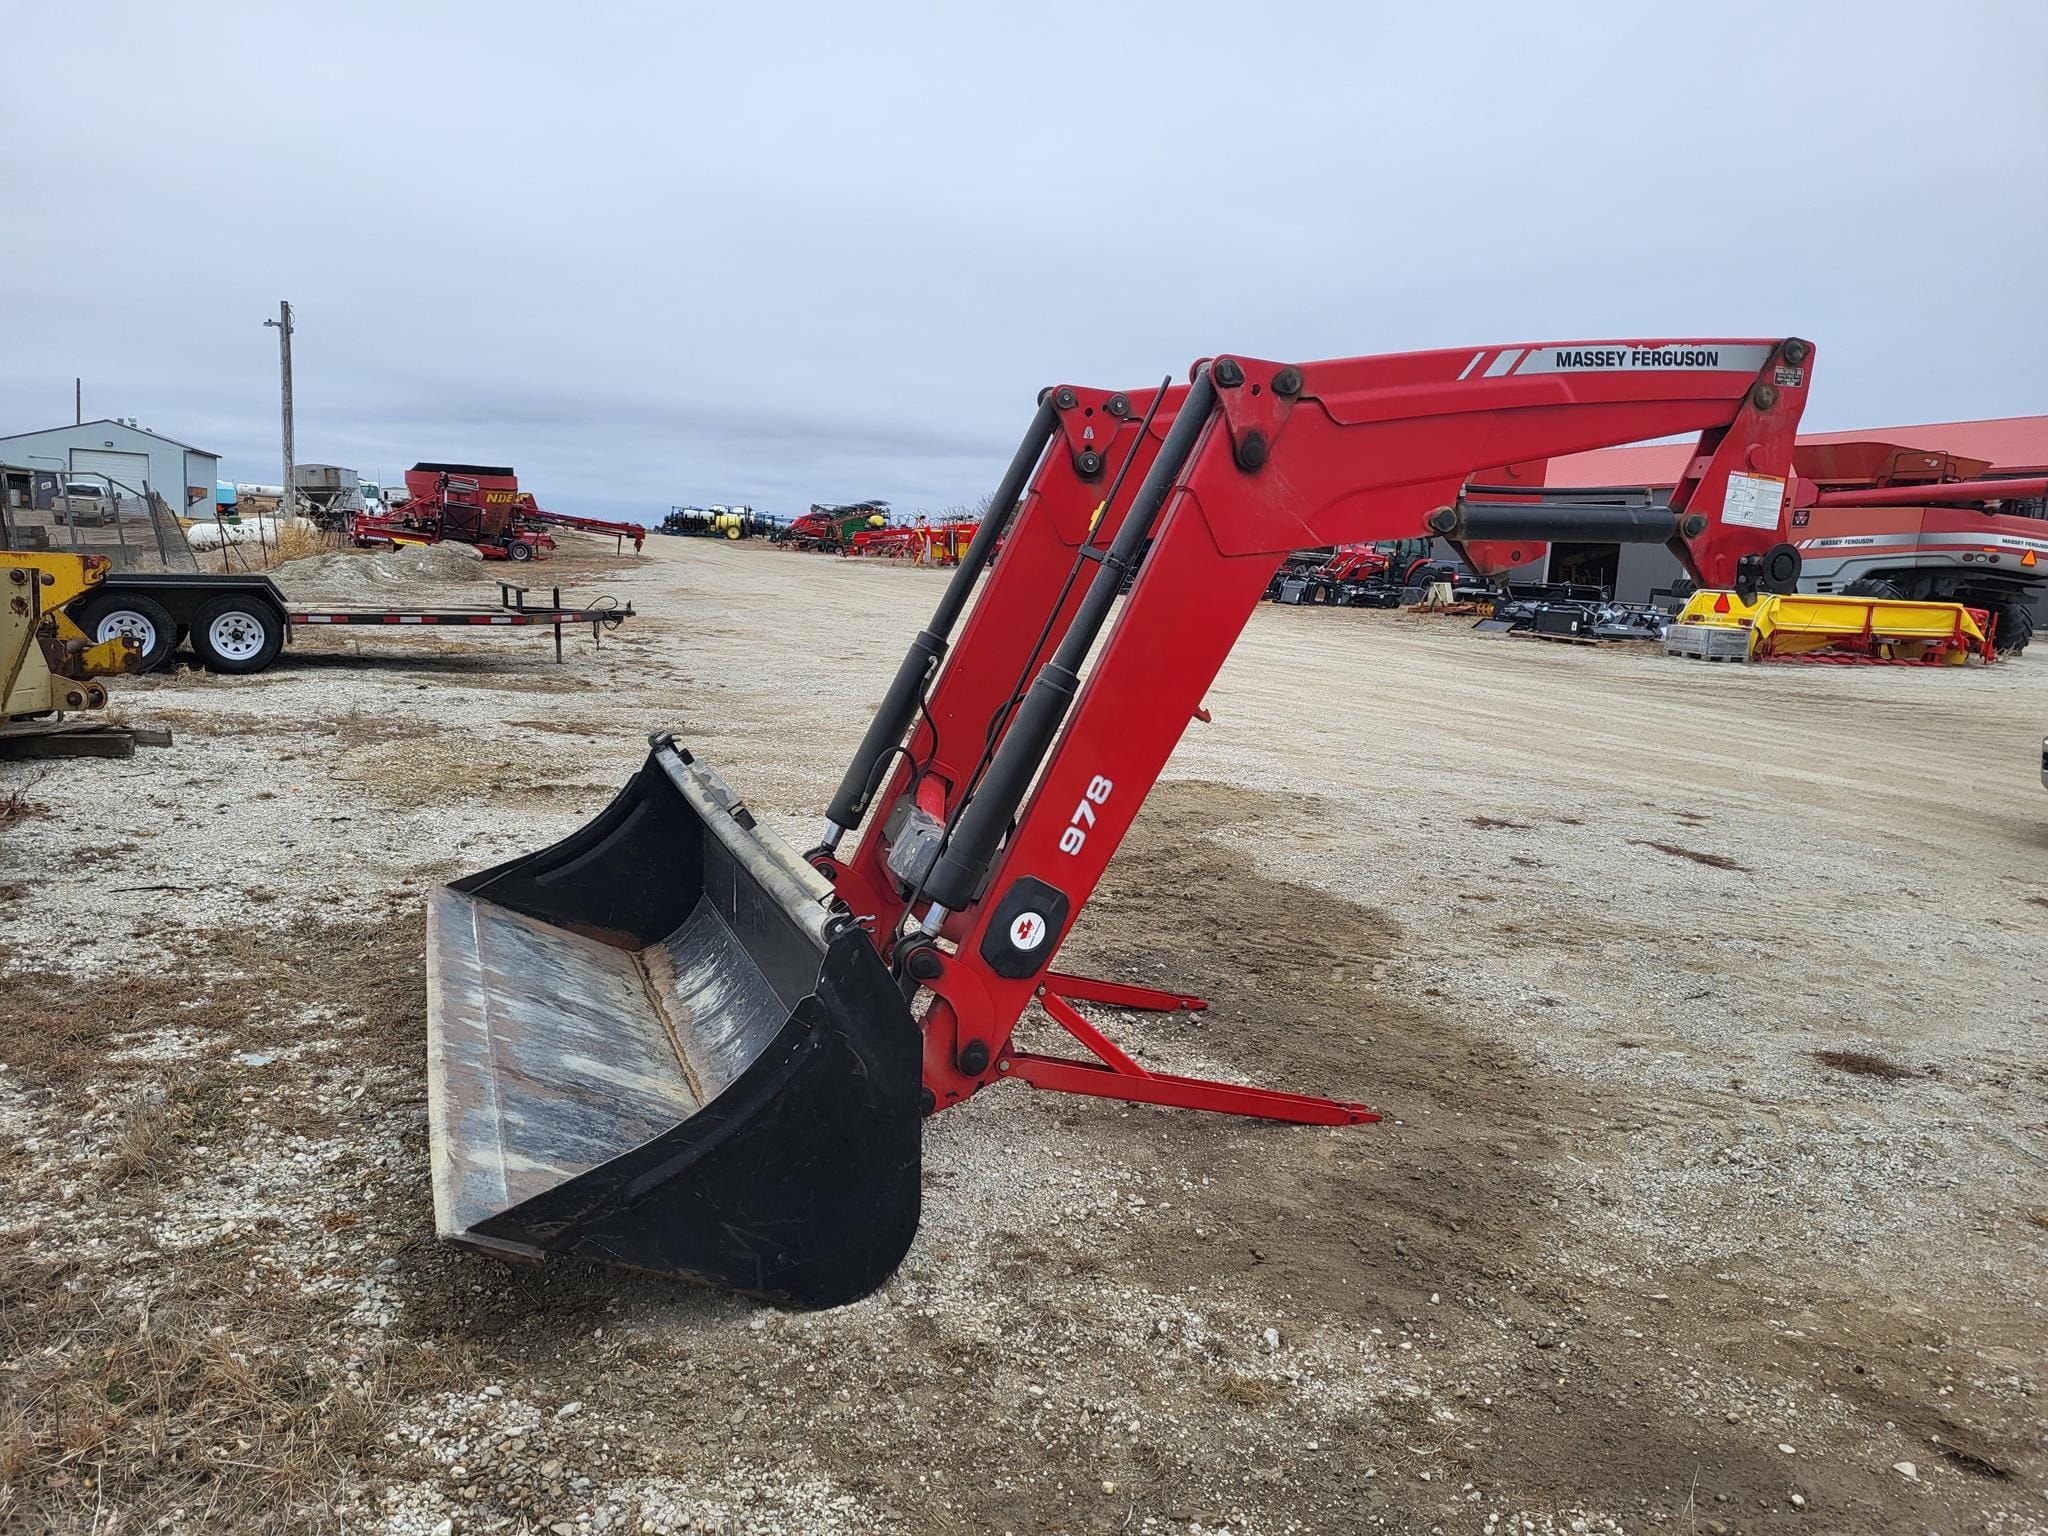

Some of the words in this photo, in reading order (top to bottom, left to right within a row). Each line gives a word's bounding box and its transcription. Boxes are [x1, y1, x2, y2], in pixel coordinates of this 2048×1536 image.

[1556, 351, 1627, 367] MASSEY
[1631, 350, 1719, 367] FERGUSON
[2002, 538, 2024, 546] MASSEY
[1059, 774, 1114, 856] 978
